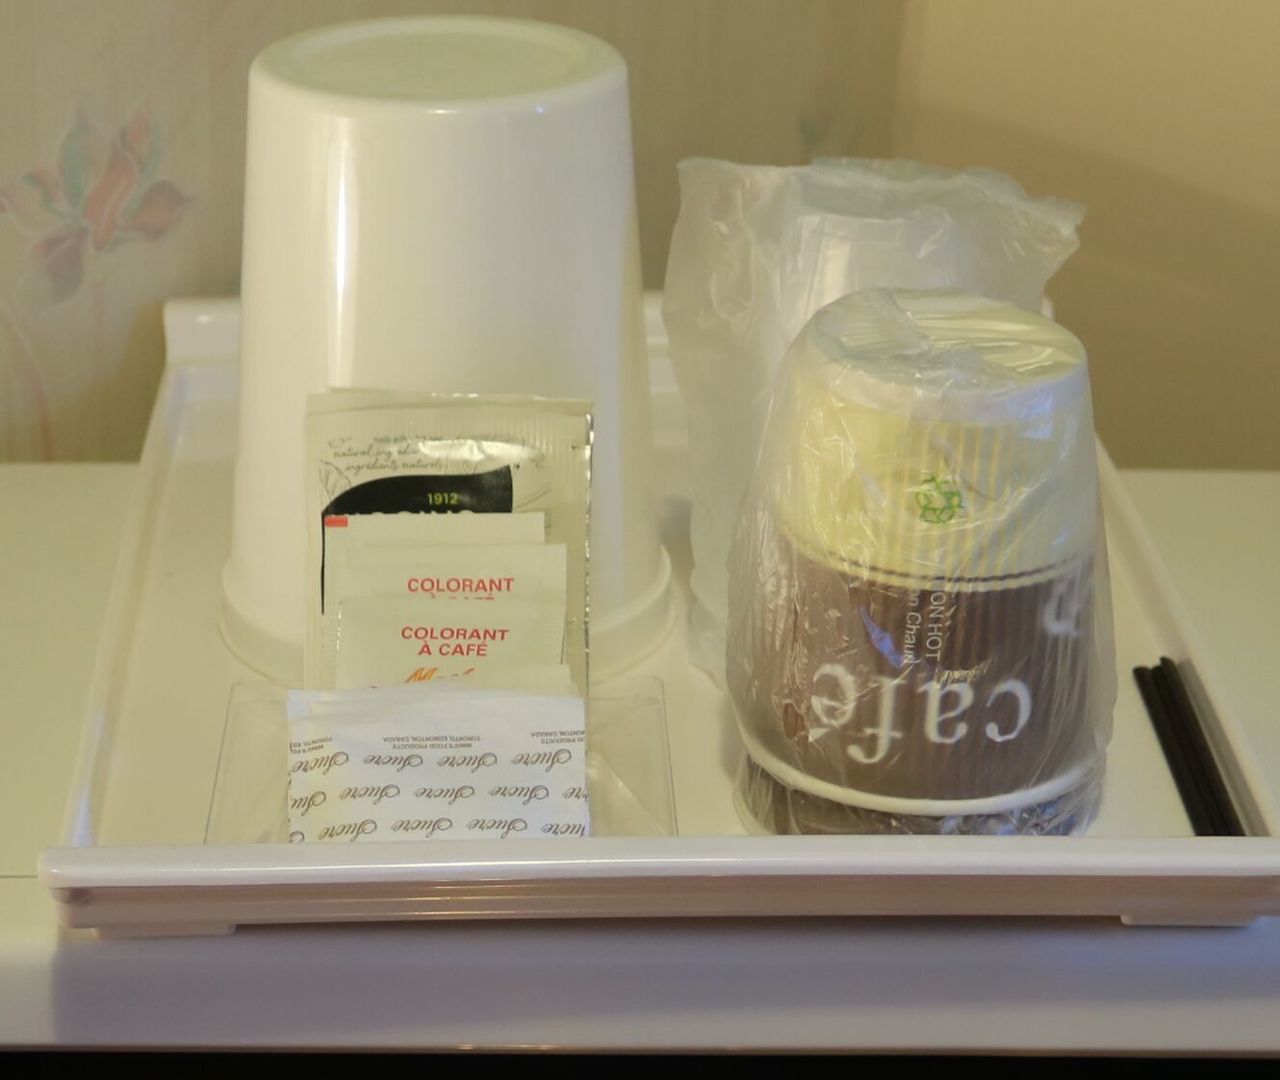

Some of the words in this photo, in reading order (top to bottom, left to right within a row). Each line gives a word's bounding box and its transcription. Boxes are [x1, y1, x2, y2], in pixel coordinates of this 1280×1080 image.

[427, 492, 459, 506] 1912
[407, 577, 515, 593] COLORANT
[401, 625, 509, 641] COLORANT
[925, 623, 943, 662] HOT
[417, 639, 433, 656] À
[438, 640, 489, 657] CAFÉ
[809, 663, 1034, 765] café
[293, 751, 349, 776] Sucre
[363, 754, 424, 773] Sucre
[437, 752, 498, 774] Sucre
[512, 748, 573, 773] Sucre
[340, 784, 400, 806] Sucre
[414, 784, 475, 806] Sucre
[488, 784, 550, 806] Sucre
[319, 819, 378, 842] Sucre
[391, 817, 453, 839] Sucre
[466, 817, 528, 840] Sucre
